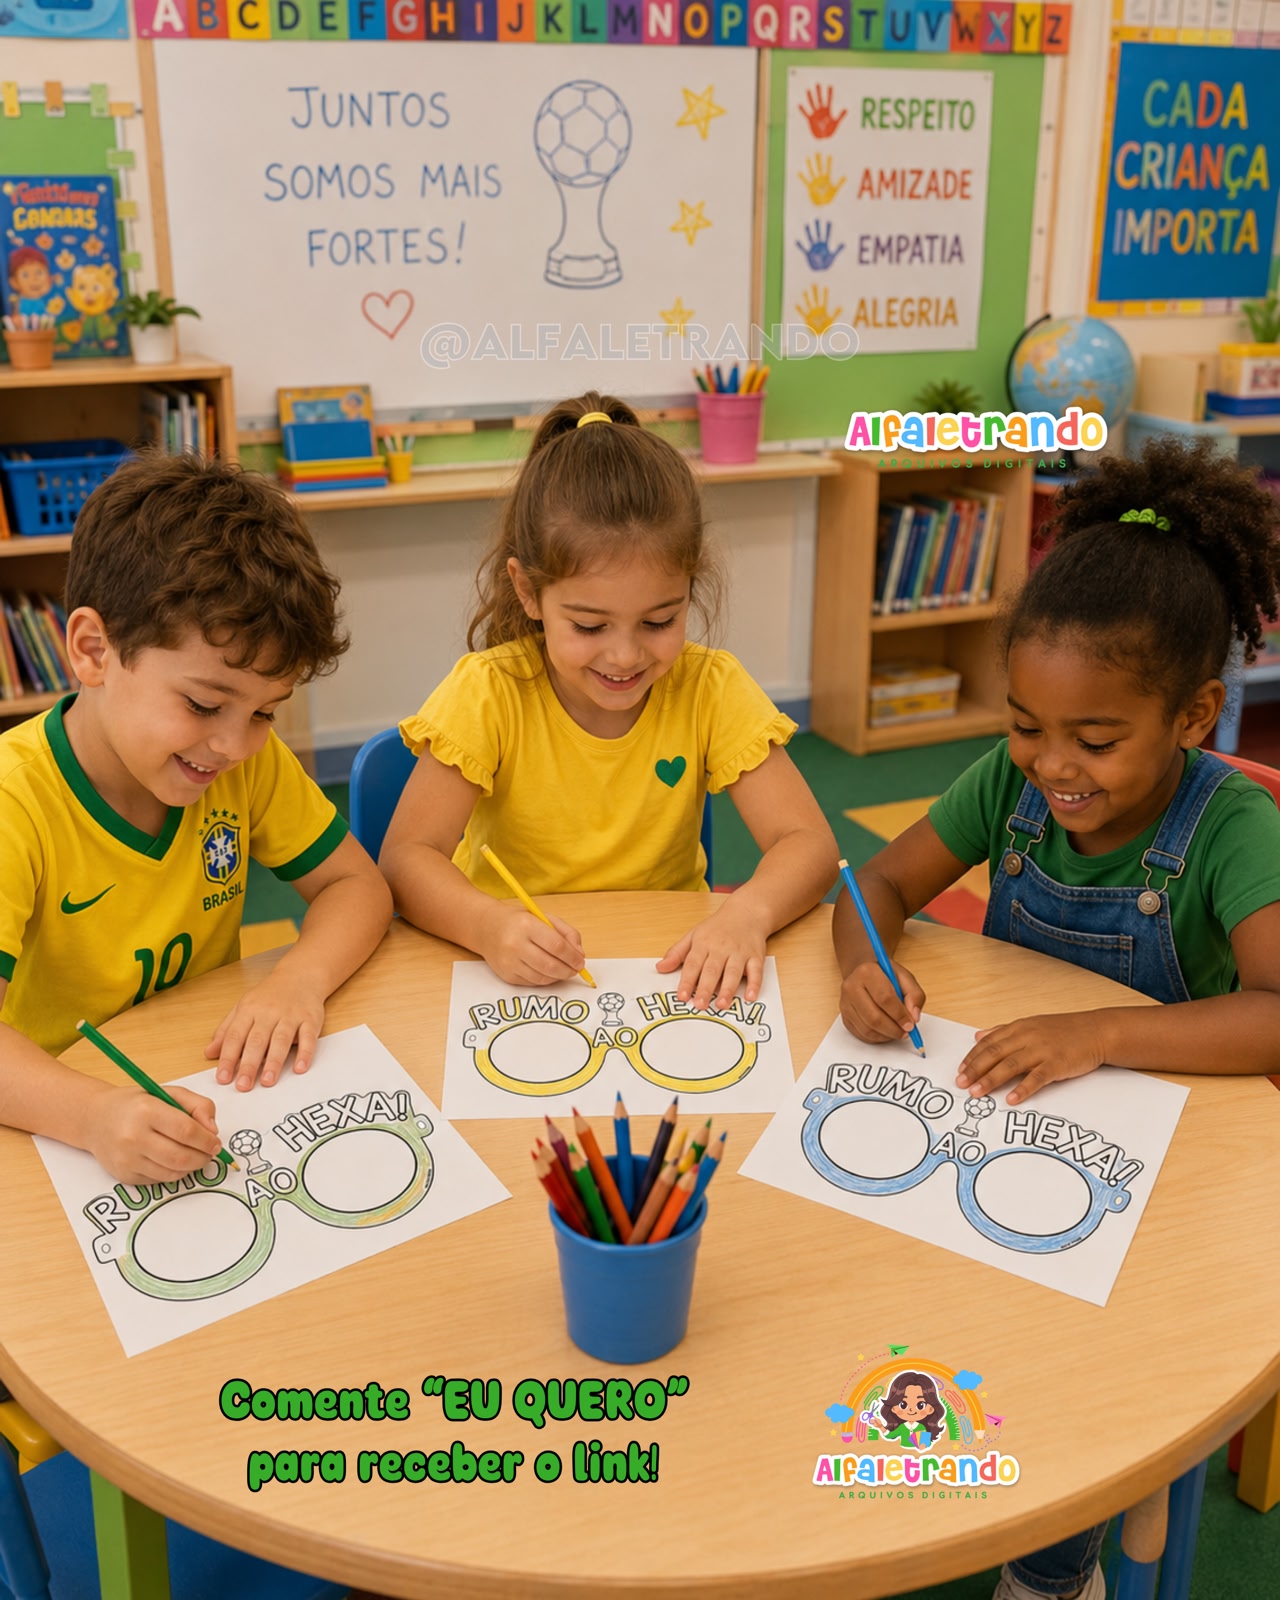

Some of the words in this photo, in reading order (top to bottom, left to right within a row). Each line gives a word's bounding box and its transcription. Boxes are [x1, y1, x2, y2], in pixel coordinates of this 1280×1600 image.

[151, 0, 185, 32] A
[198, 0, 219, 30] B
[237, 0, 259, 30] C
[278, 0, 301, 31] D
[318, 0, 338, 31] E
[358, 1, 376, 31] F
[392, 0, 418, 34] G
[430, 1, 455, 34] H
[475, 2, 484, 34] I
[507, 2, 524, 33] J
[544, 3, 563, 34] K
[580, 2, 598, 35] L
[613, 4, 638, 36] M
[648, 2, 673, 38] N
[684, 3, 709, 39] O
[721, 4, 743, 40] P
[753, 6, 779, 42] Q
[789, 5, 812, 43] R
[822, 6, 845, 43] S
[858, 9, 878, 42] T
[889, 9, 911, 43] U
[918, 9, 947, 42] V
[954, 12, 980, 44] W
[987, 12, 1008, 45] X
[1019, 14, 1036, 44] Y
[1046, 15, 1063, 45] Z
[287, 86, 451, 129] JUNTOS
[860, 97, 976, 133] RESPEITO
[1143, 79, 1249, 130] CADA
[263, 163, 396, 202] SOMOS
[420, 164, 502, 200] MAIS
[857, 168, 973, 202] AMIZADE
[1114, 142, 1270, 200] CRIANÇA
[307, 221, 467, 268] FORTES!
[857, 234, 966, 266] EMPATIA
[1112, 208, 1259, 256] IMPORTA
[852, 296, 960, 330] ALEGRIA
[202, 881, 244, 911] BRASIL
[132, 932, 193, 1006] 10
[469, 995, 590, 1029] RUMO
[592, 1027, 639, 1048] AO
[246, 1166, 298, 1207] AO
[272, 1089, 408, 1152] HEXA!
[827, 1063, 954, 1119] RUMO
[930, 1132, 987, 1166] AO
[1004, 1110, 1144, 1187] HEXA!
